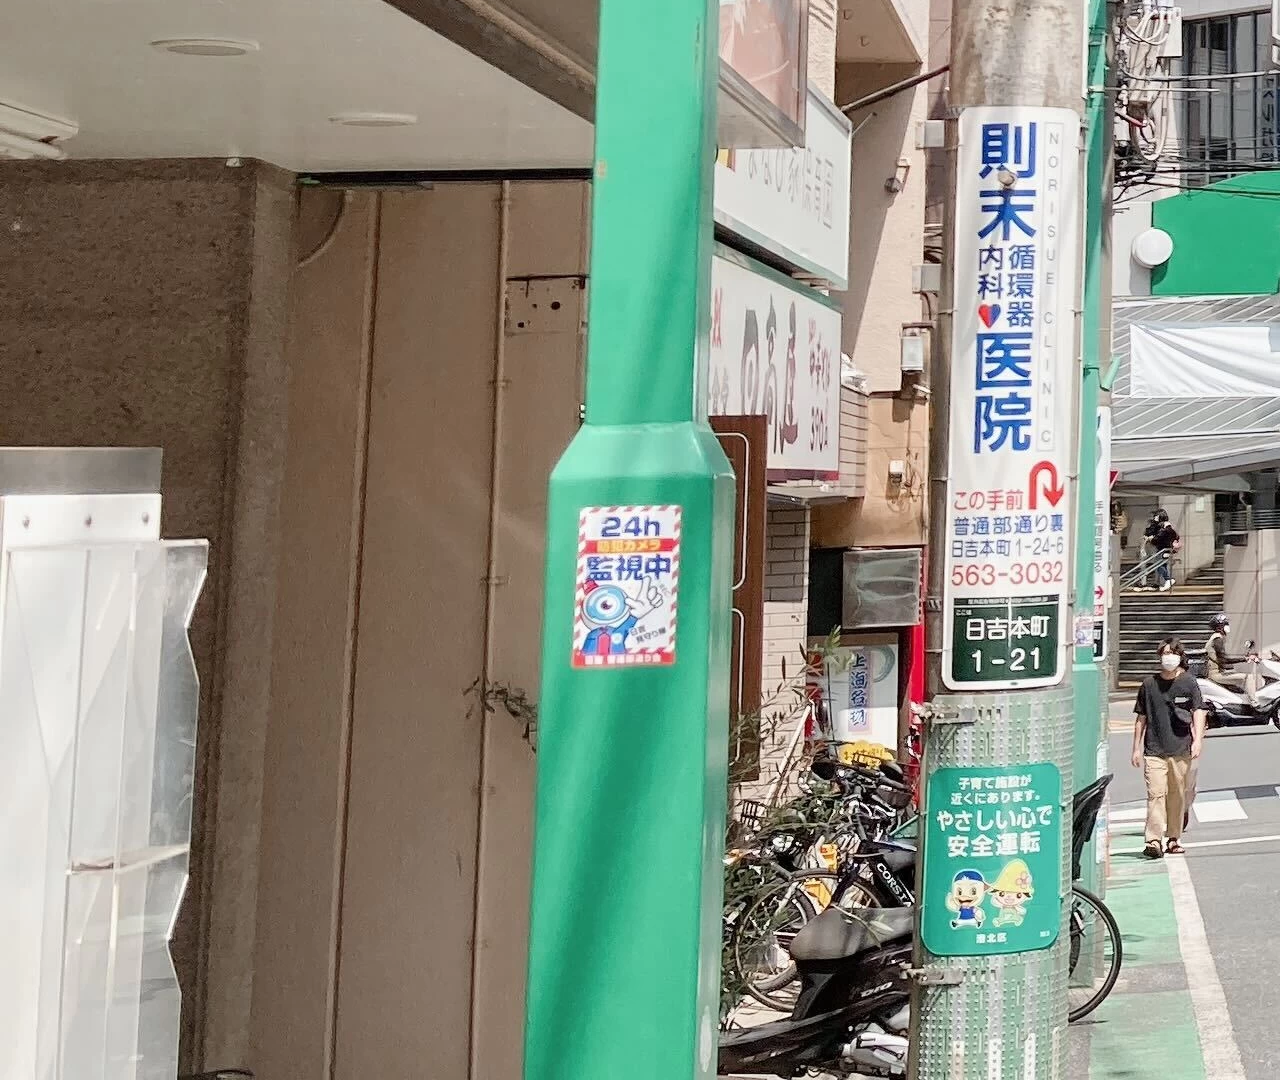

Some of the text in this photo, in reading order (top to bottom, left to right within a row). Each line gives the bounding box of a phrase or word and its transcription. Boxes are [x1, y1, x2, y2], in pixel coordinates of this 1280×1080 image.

[978, 245, 1004, 300] 内科
[1006, 244, 1035, 328] 循環器
[1040, 311, 1055, 443] CLINIC
[973, 331, 1034, 454] 医院
[953, 488, 1024, 512] この手前
[601, 516, 661, 538] 24h
[953, 513, 1064, 536] 普通部通り裏
[952, 537, 1064, 558] 日吉本町 1-24-6
[586, 554, 672, 582] 監視中
[951, 561, 1064, 587] 563-3032
[966, 615, 1050, 641] 日吉本町
[971, 647, 1041, 673] 1-21
[950, 789, 1041, 806] 近くにあります。
[936, 804, 1054, 833] やさしい心で
[947, 831, 1042, 858] 安全運転
